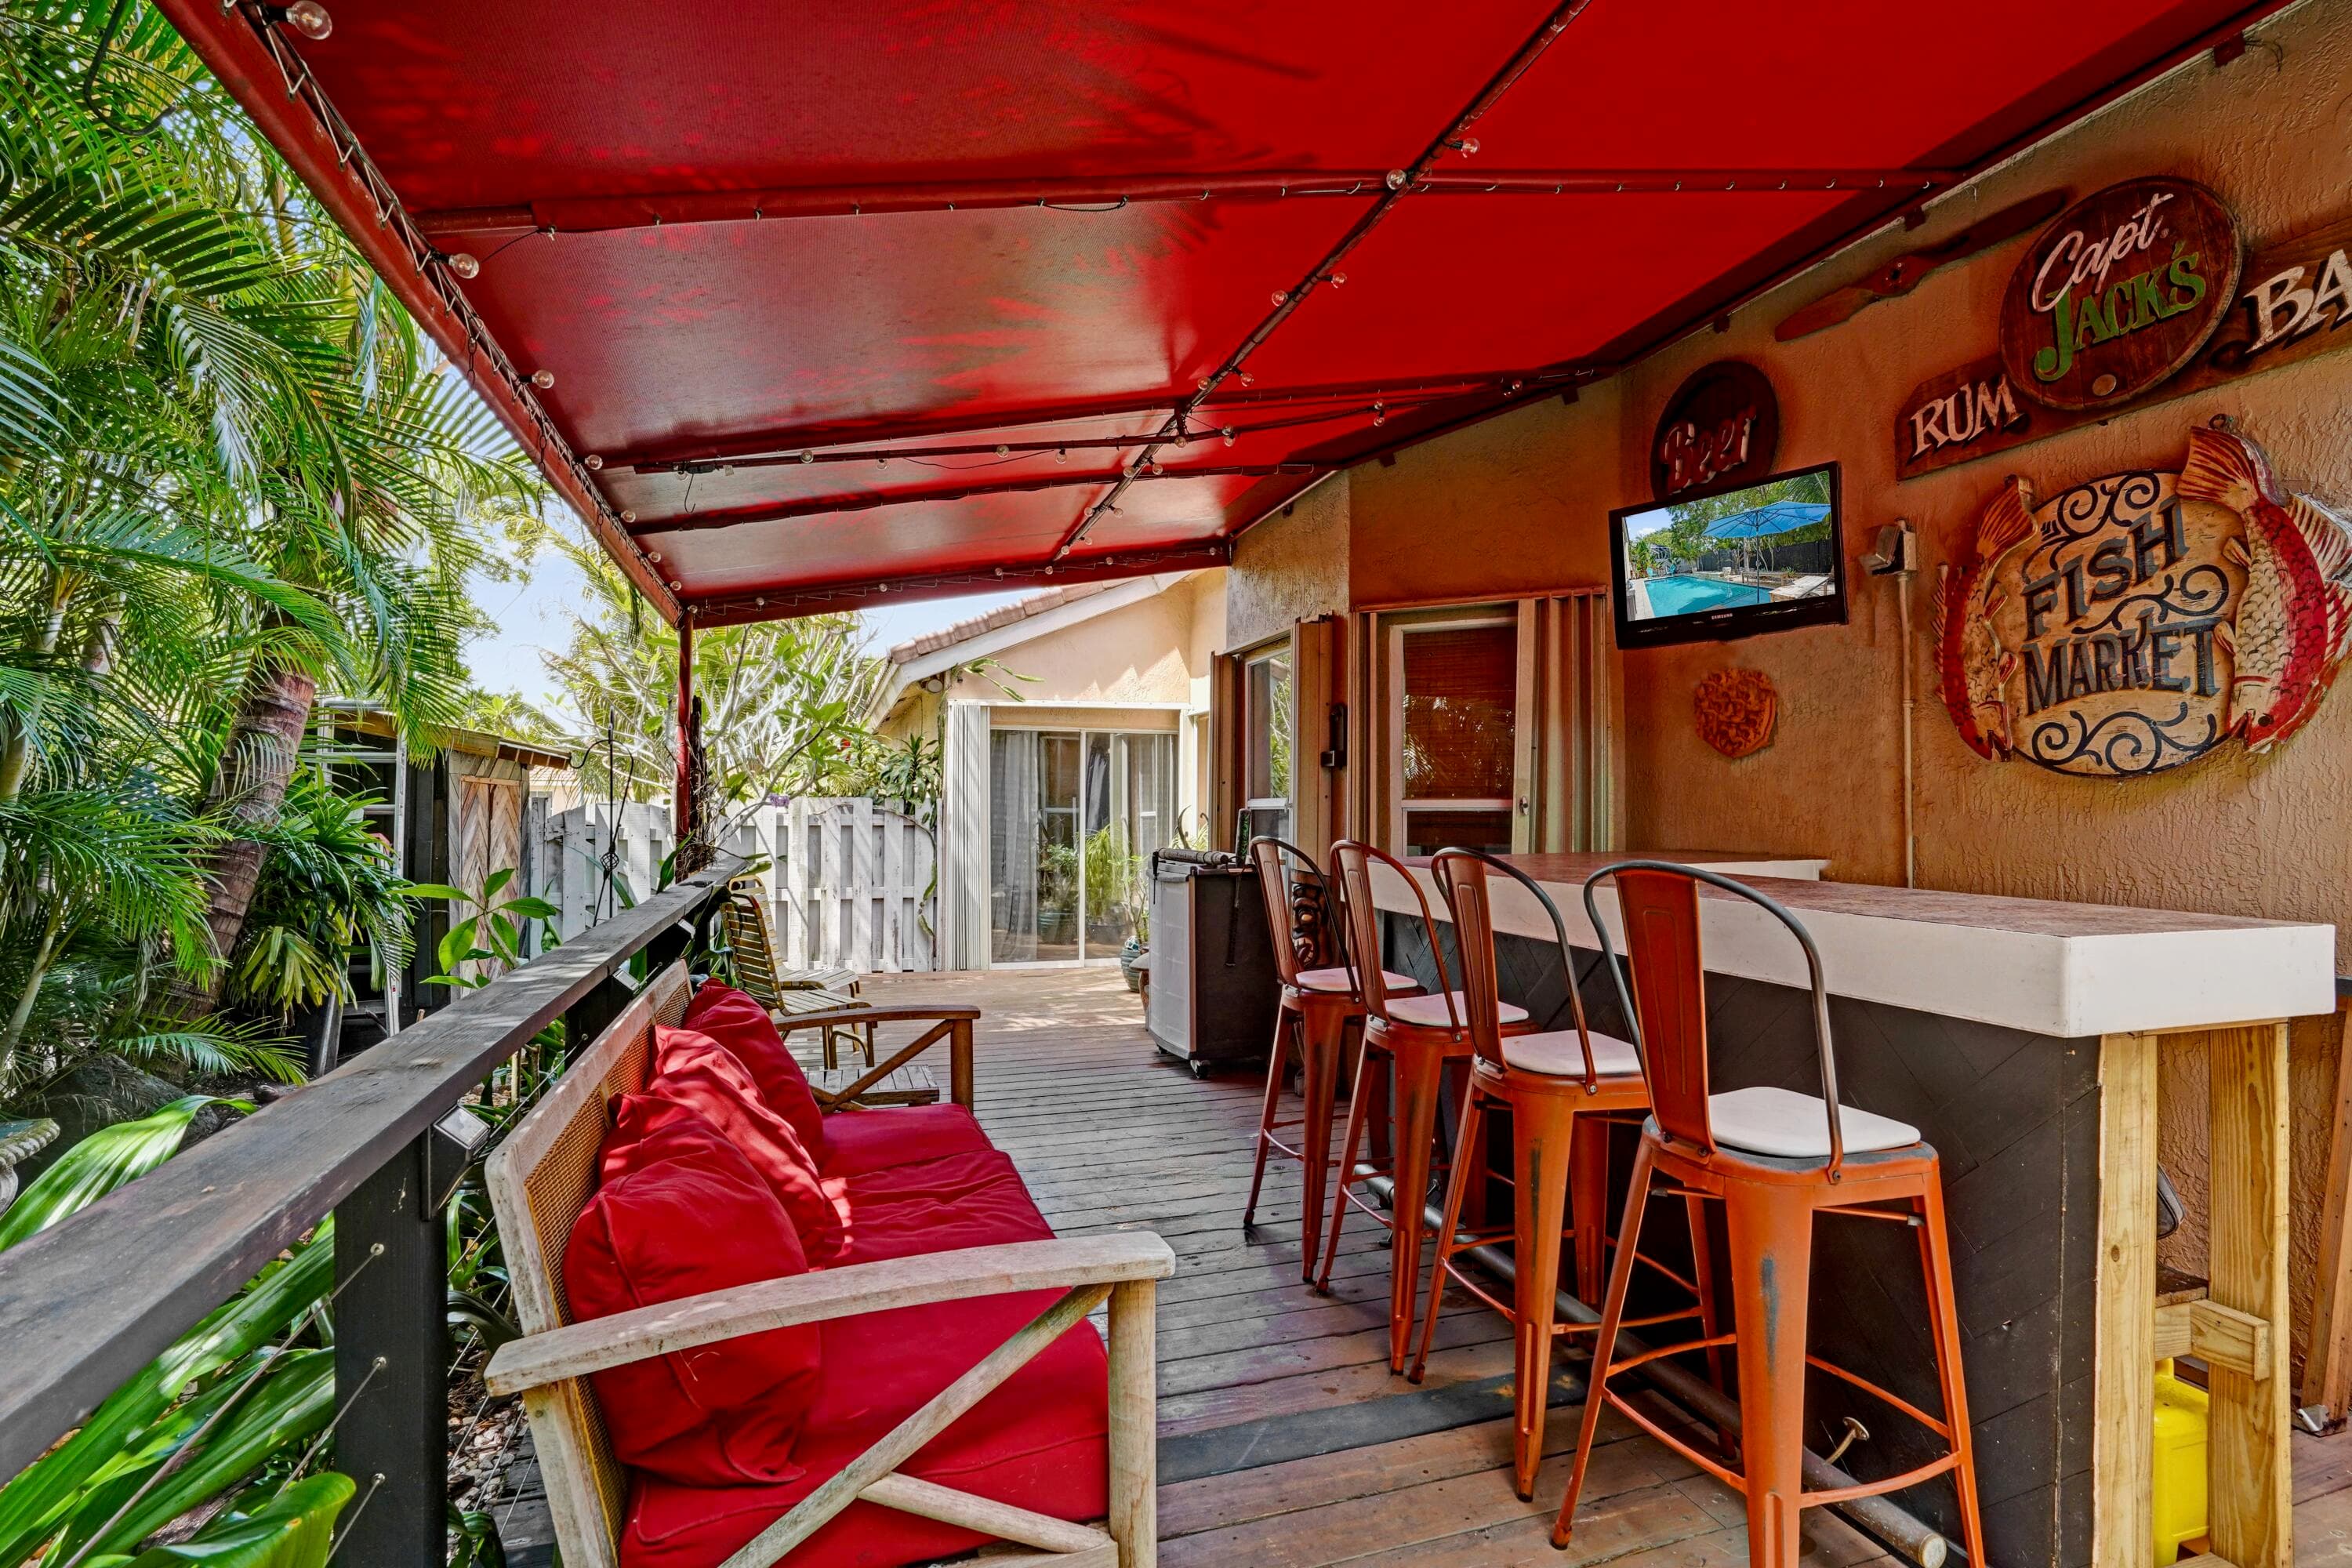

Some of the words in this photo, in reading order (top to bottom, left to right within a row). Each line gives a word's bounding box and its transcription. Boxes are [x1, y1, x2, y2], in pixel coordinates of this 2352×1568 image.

[2032, 193, 2174, 312] Capt.
[2034, 241, 2206, 381] JACK'S
[1658, 405, 1756, 495] Beer
[1910, 374, 2024, 456] RUM
[2020, 496, 2190, 644] FISH
[2020, 609, 2223, 716] MARKET
